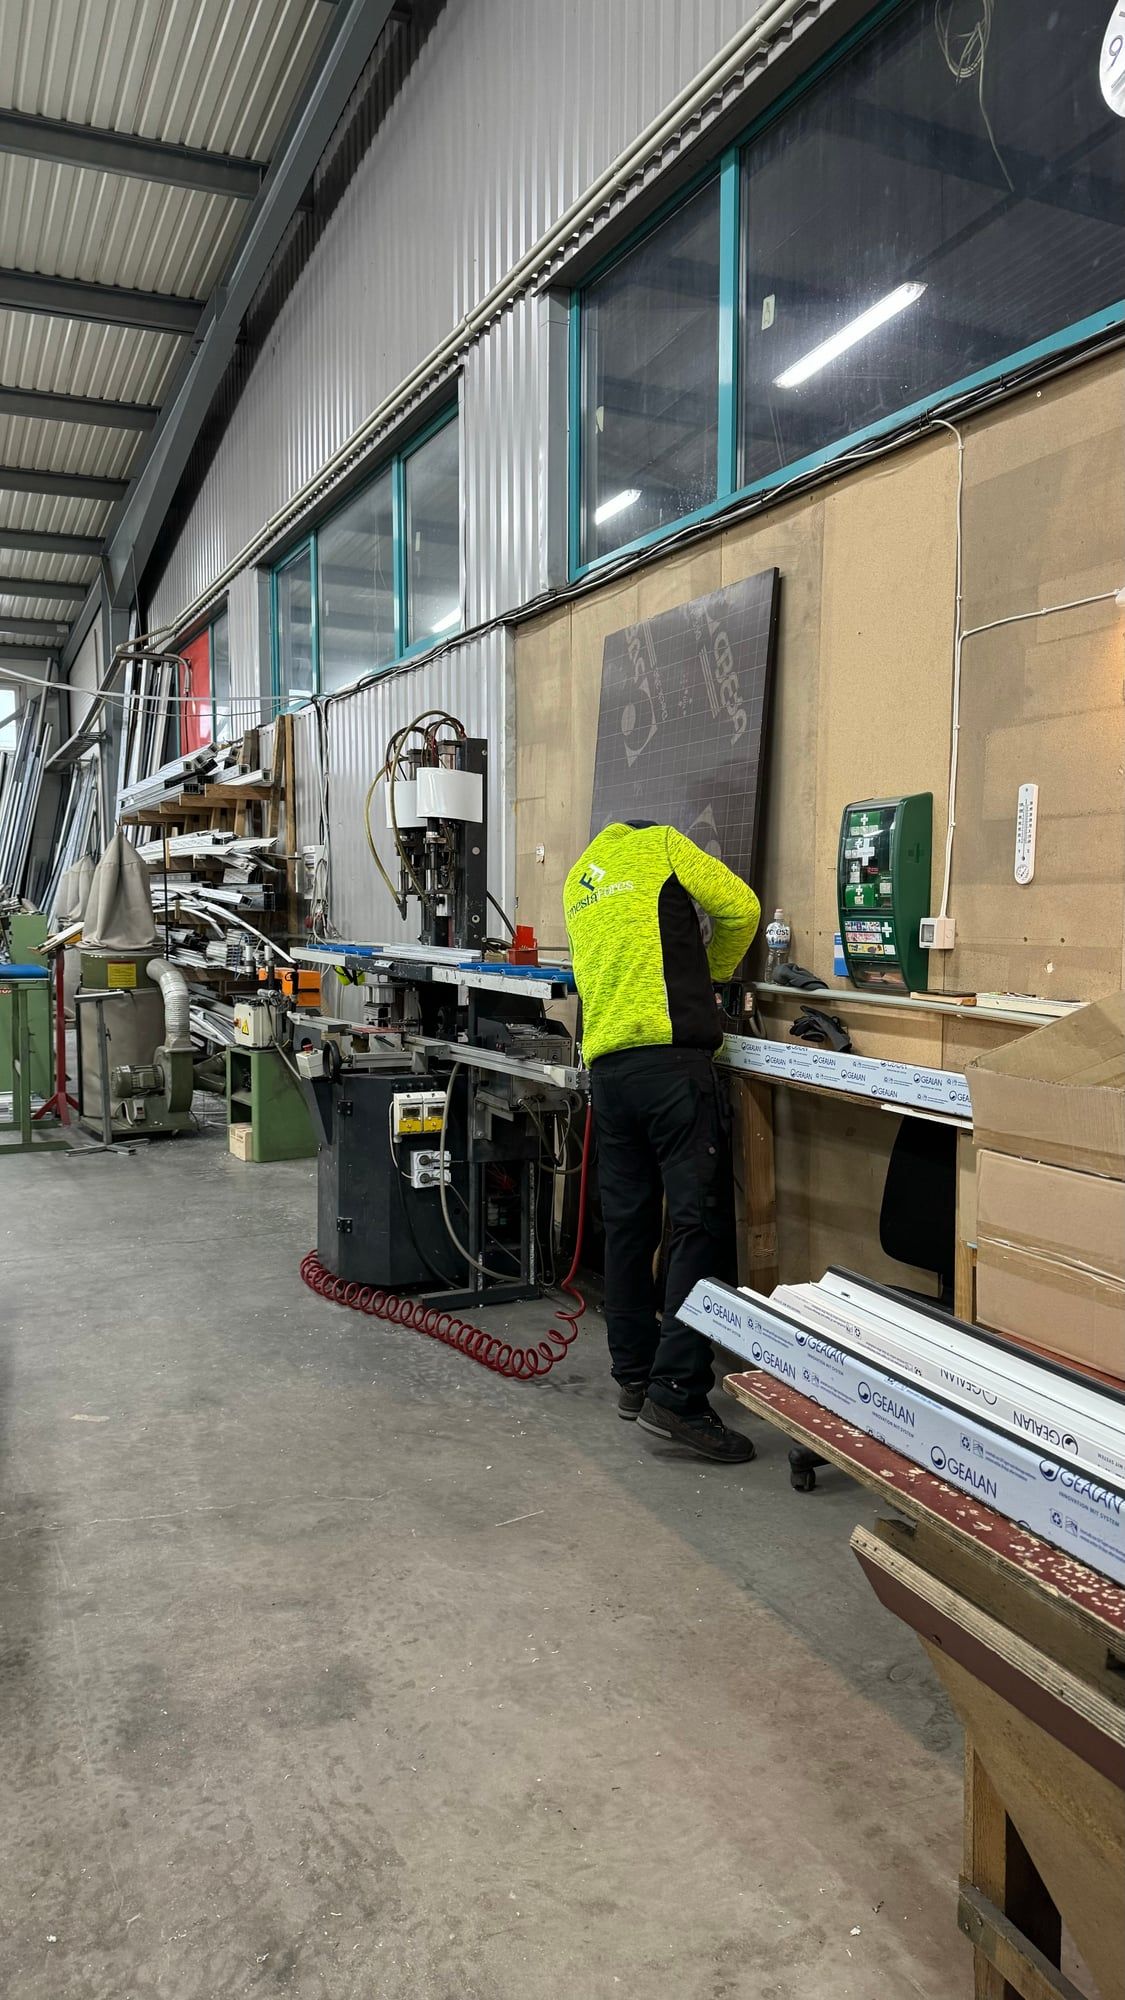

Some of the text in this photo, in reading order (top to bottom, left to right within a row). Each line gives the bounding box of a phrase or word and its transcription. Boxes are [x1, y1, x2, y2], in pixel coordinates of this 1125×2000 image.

[1107, 35, 1123, 72] 9
[920, 1075, 943, 1087] GEALAN
[712, 1302, 742, 1330] GEALAN
[762, 1350, 797, 1381] GEALAN
[807, 1336, 848, 1367] GEALAN
[872, 1391, 916, 1428] GEALAN
[1013, 1410, 1061, 1446] GEALAN
[947, 1457, 997, 1499] GEALAN
[1060, 1470, 1125, 1515] GEALAN
